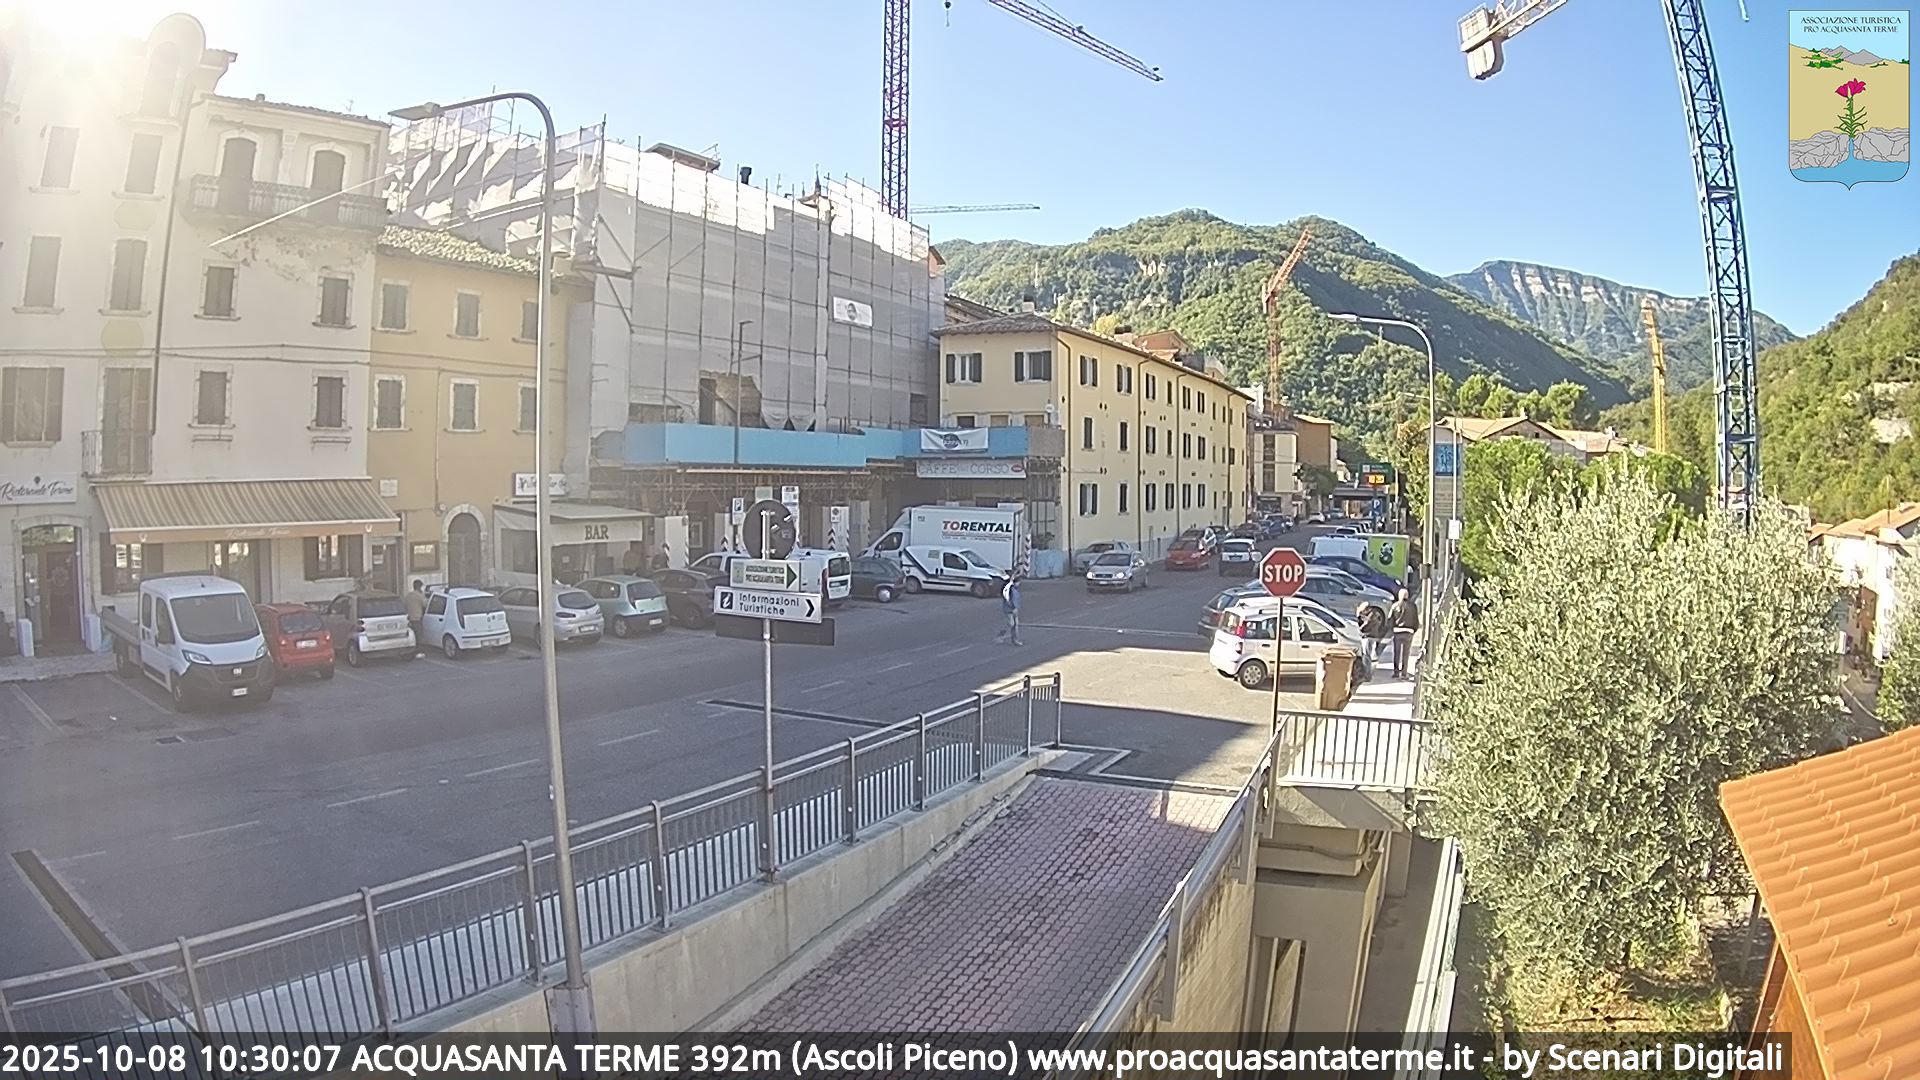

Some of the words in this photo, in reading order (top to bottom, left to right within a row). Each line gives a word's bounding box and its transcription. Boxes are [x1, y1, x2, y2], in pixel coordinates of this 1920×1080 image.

[584, 525, 609, 540] BAR
[942, 520, 1012, 533] TORENTAL
[1264, 564, 1303, 583] STOP
[739, 593, 800, 606] Informazioni
[739, 602, 785, 615] Turistiche
